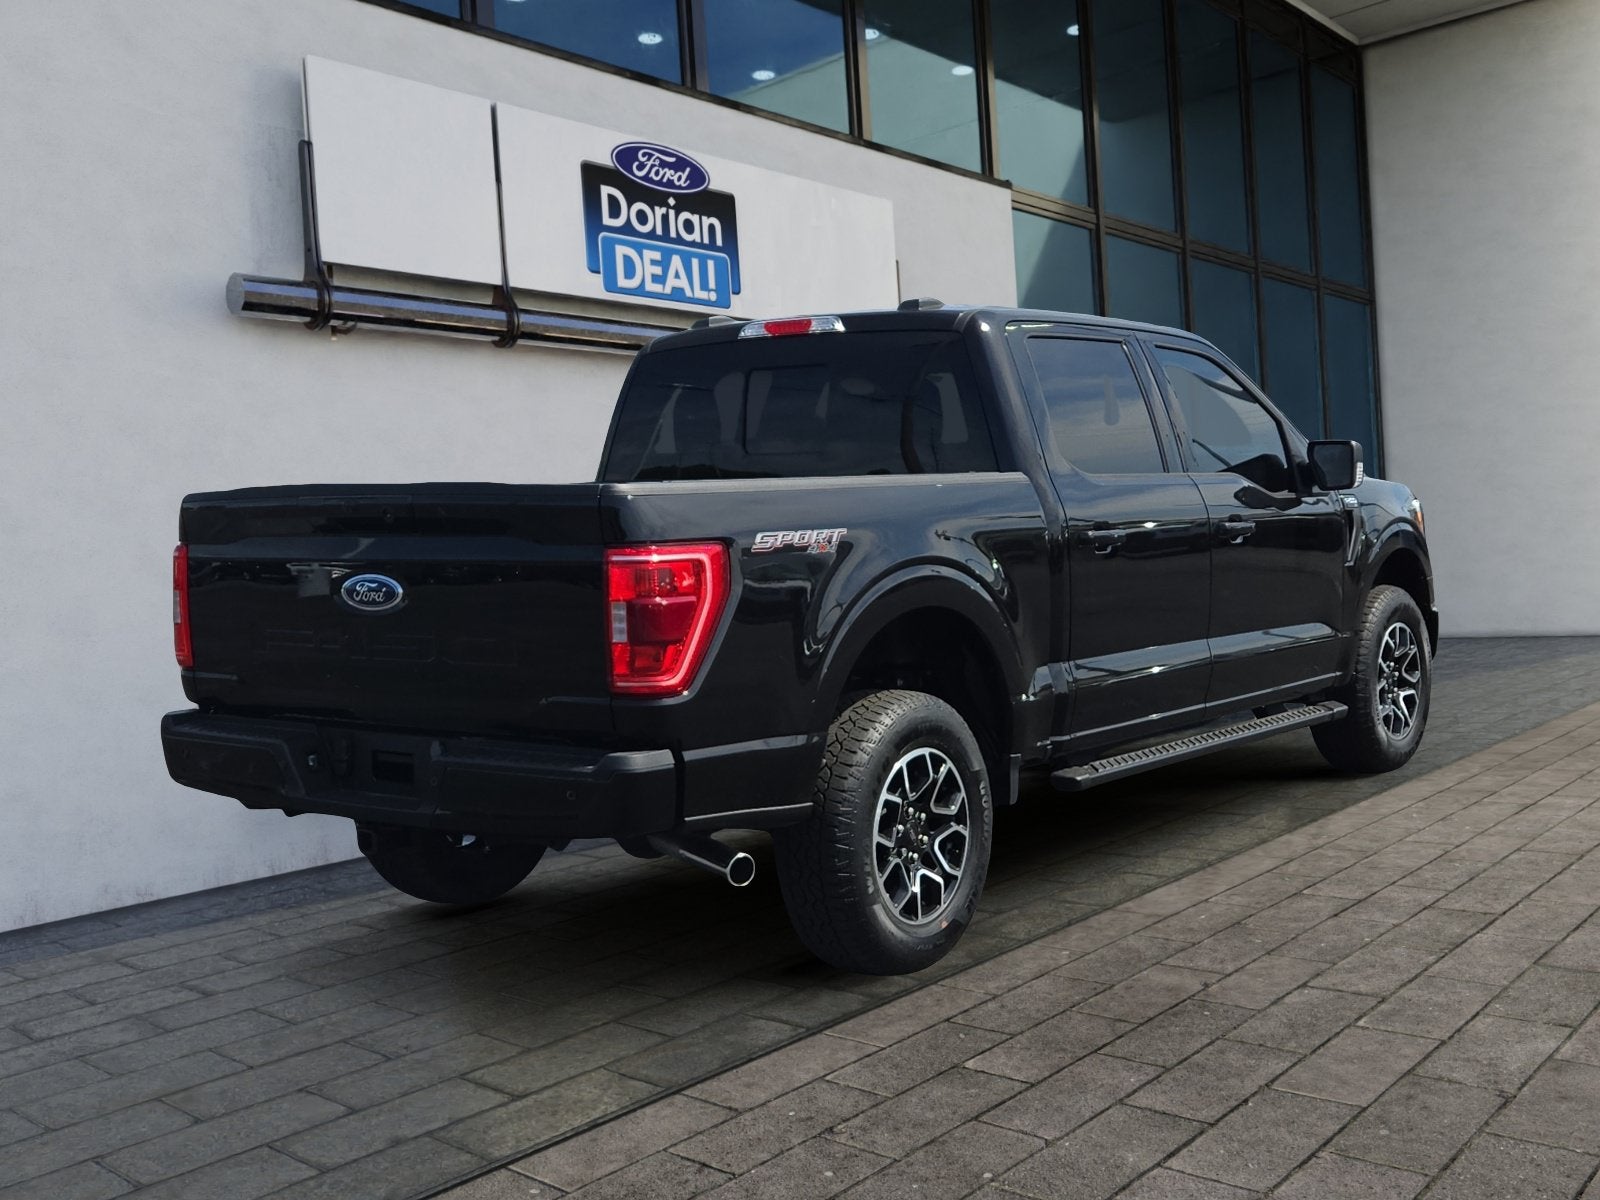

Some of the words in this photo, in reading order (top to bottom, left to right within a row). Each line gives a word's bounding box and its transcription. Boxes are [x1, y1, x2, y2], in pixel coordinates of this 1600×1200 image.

[632, 149, 691, 187] Ford
[600, 184, 723, 247] Dorian
[614, 244, 718, 302] DEAL!
[751, 527, 848, 553] SPORT
[353, 581, 387, 602] Ford
